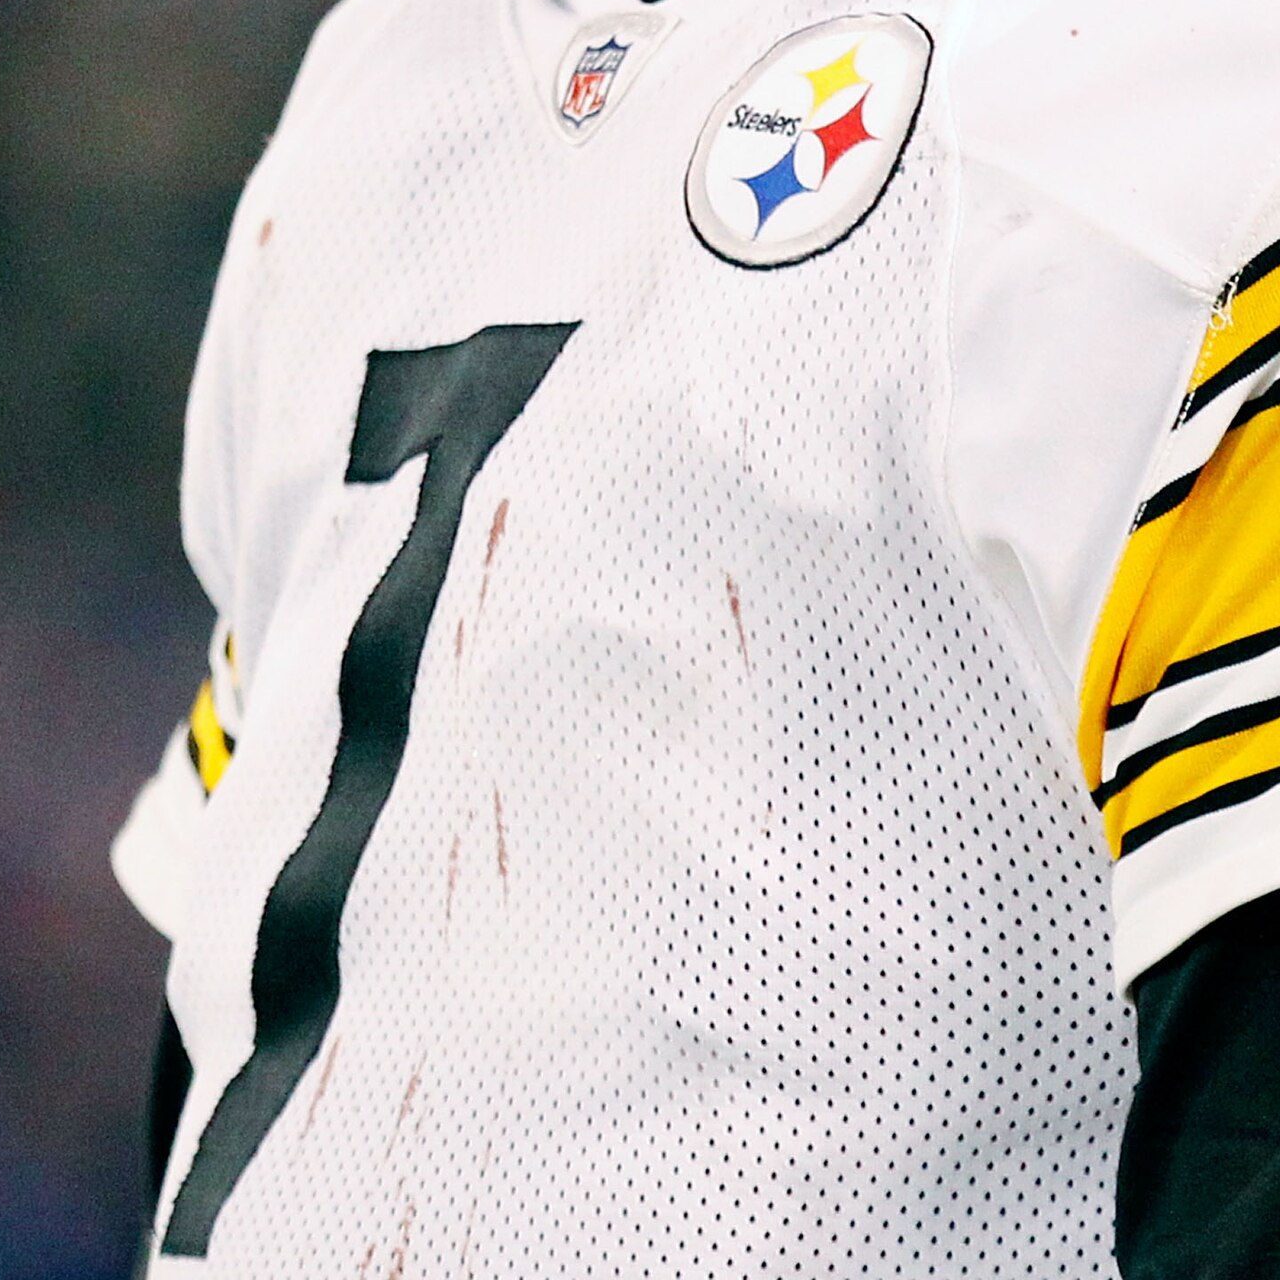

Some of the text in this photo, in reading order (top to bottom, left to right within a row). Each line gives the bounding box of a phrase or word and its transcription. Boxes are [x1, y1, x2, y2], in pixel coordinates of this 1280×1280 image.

[563, 73, 606, 114] NFL
[727, 104, 802, 137] Steelers
[161, 321, 582, 1258] 7
